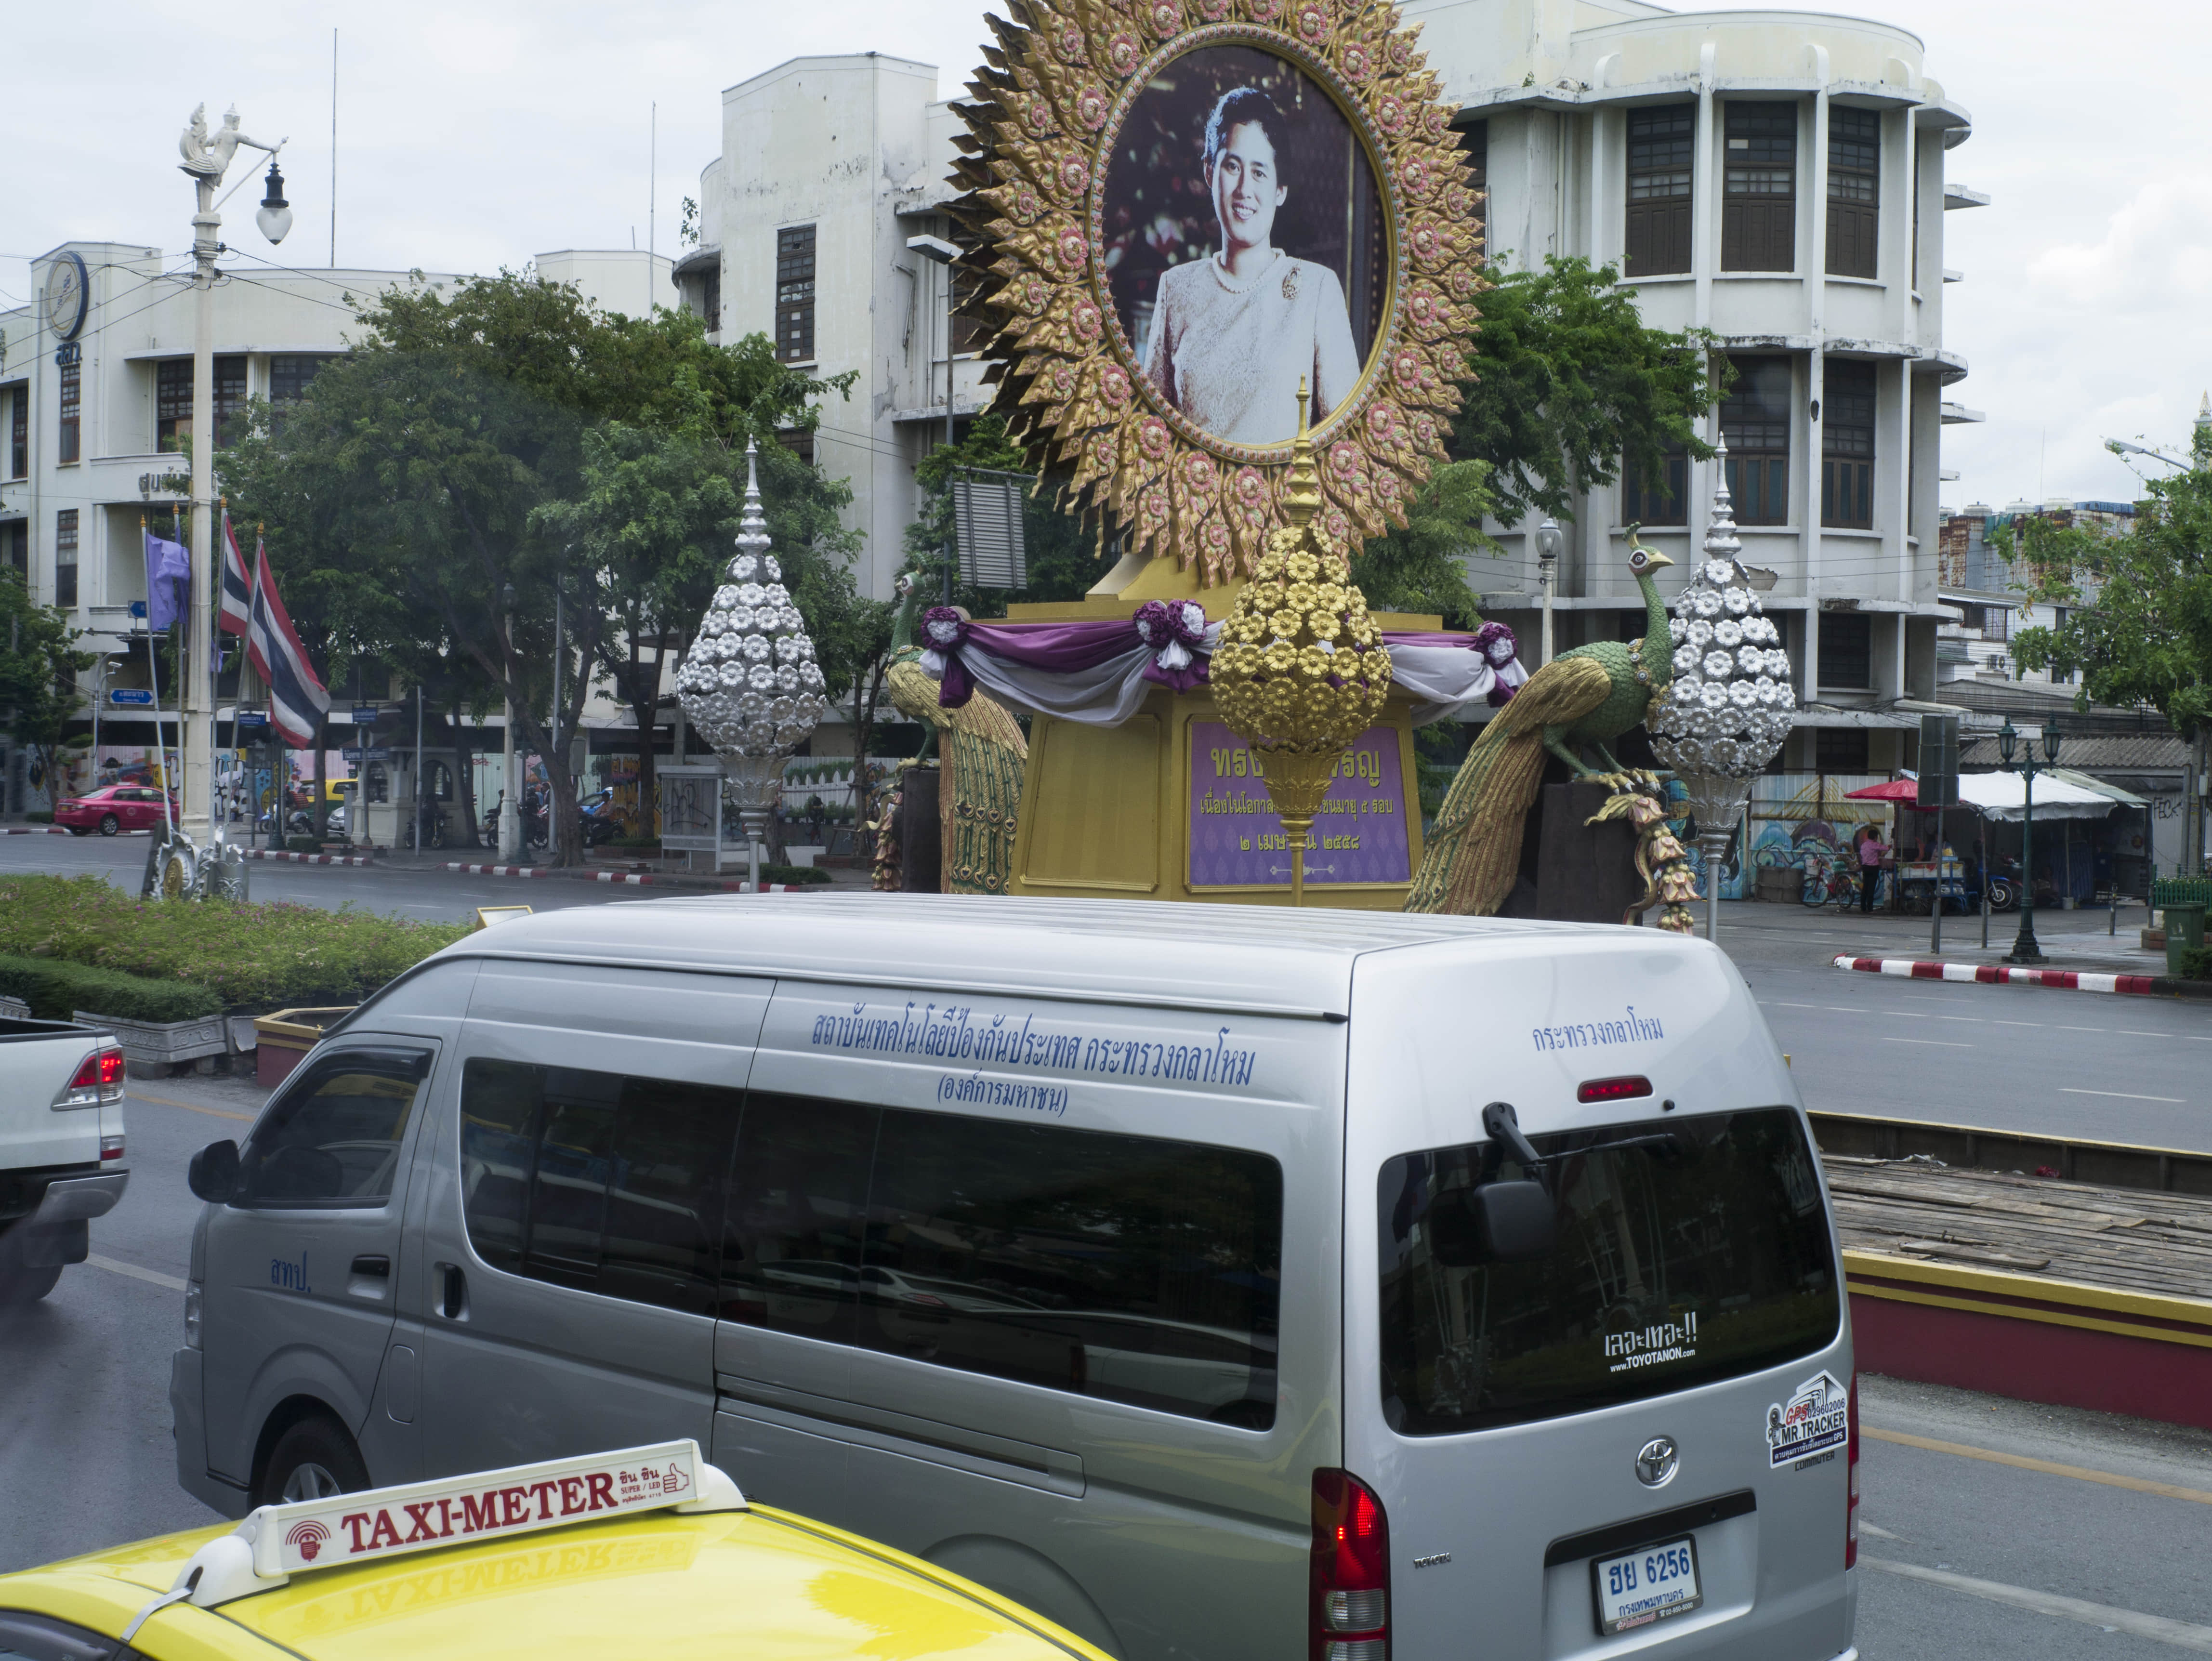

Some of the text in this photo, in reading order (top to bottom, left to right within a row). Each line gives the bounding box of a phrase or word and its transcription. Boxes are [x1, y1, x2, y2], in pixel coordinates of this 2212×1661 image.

[1361, 801, 1369, 814] ๕
[1372, 799, 1393, 814] รอบ
[1240, 834, 1360, 851] ๒ เมษน ๒๕๕๘
[1533, 1005, 1663, 1051] กระทรวงกลาโหม
[812, 1002, 1256, 1086] สถาบันเทคโนโลยีป้องกันประเทศ กระทรวงกลาโหม
[937, 1068, 1068, 1118] (องค์การมหาชน)
[271, 1250, 311, 1293] สทป.
[1605, 1311, 1697, 1356] เลอะเทอะ!!
[1610, 1347, 1696, 1372] www.TOYOTANON.com
[1786, 1398, 1845, 1425] GPS 029602006
[1782, 1411, 1844, 1444] MR.TRACKER
[1833, 1431, 1843, 1441] GPS
[1795, 1450, 1835, 1471] COMMUTER
[621, 1485, 640, 1494] SUPER
[649, 1481, 660, 1490] LED
[341, 1473, 618, 1553] TAXI-METER
[1414, 1552, 1451, 1569] TOYOTA
[1646, 1547, 1690, 1584] 6256
